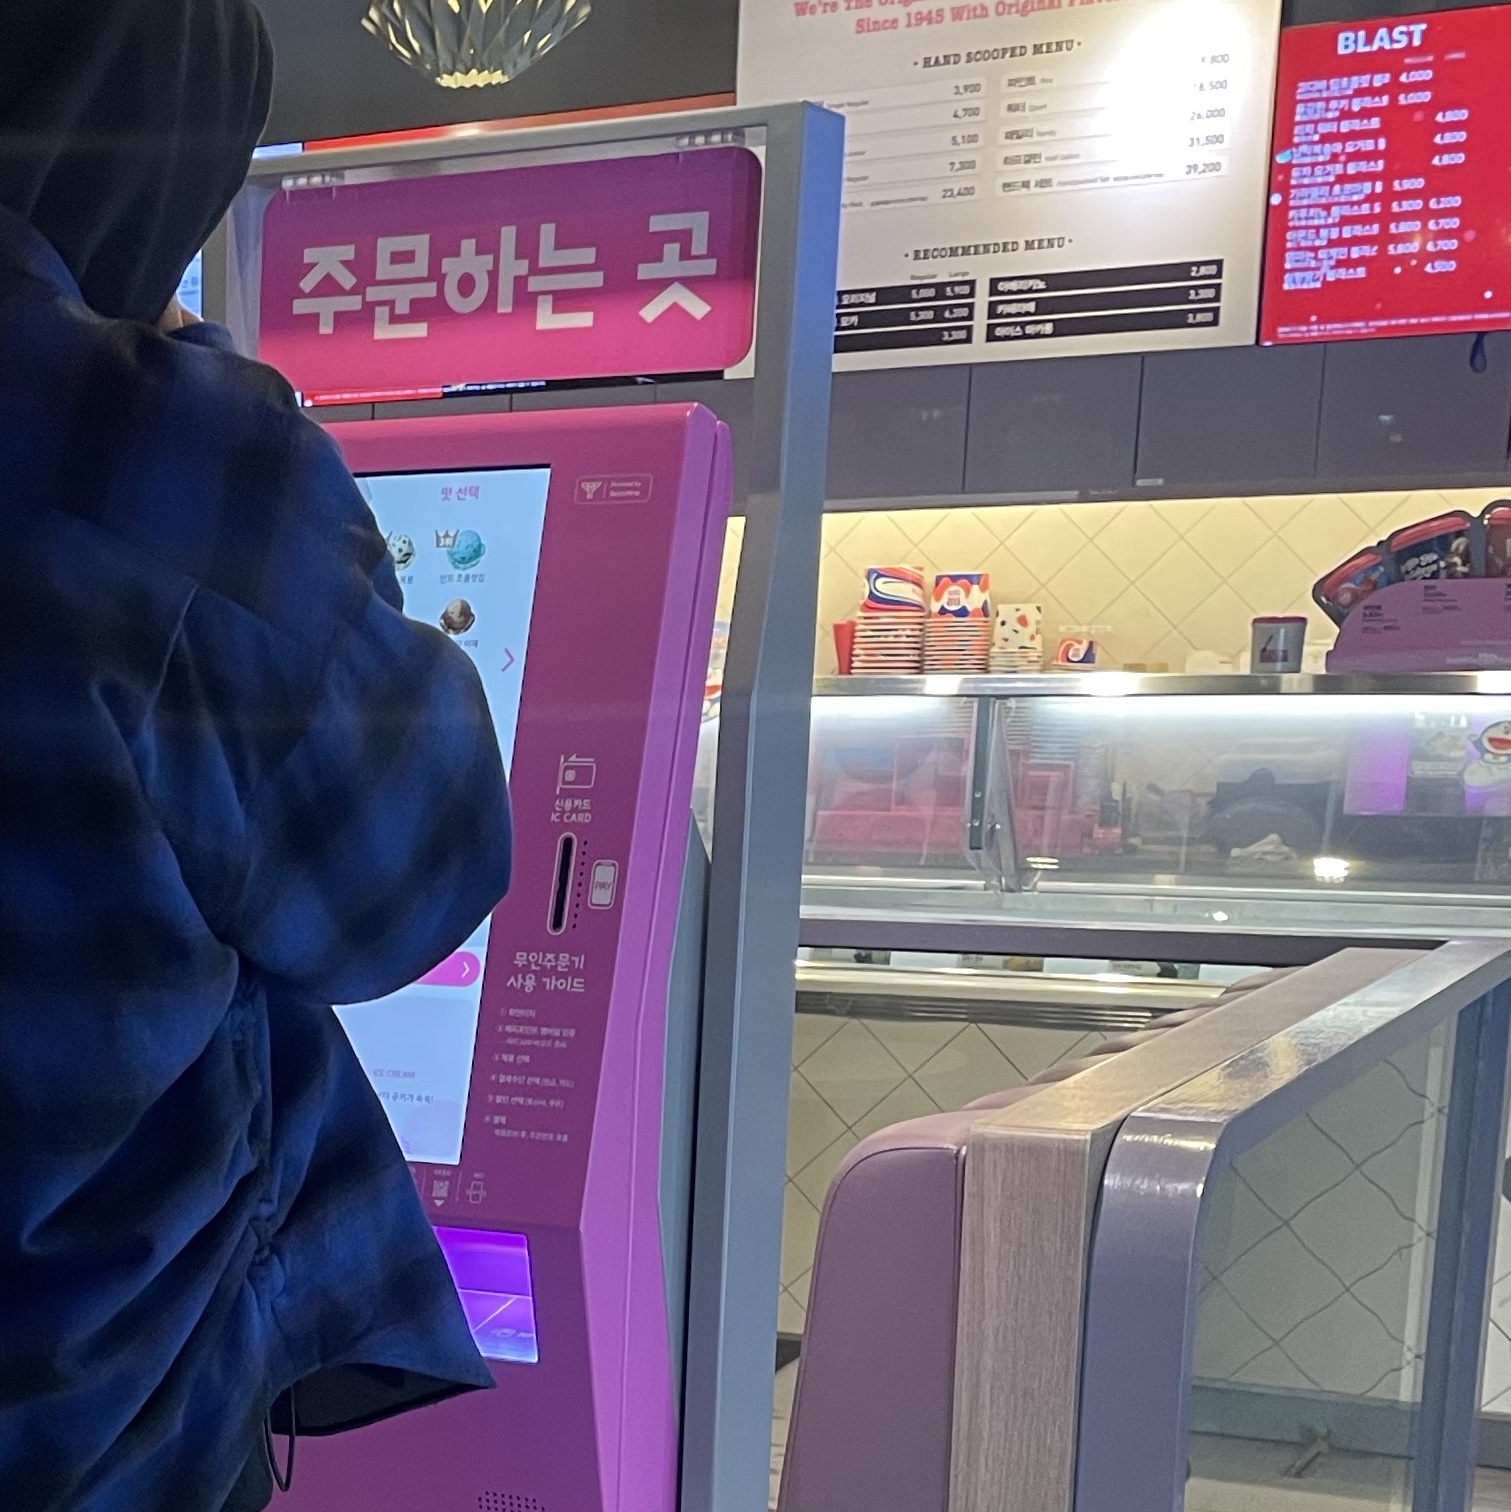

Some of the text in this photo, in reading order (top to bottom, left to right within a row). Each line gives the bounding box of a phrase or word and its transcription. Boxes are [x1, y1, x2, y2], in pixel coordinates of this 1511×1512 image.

[855, 17, 899, 34] Since
[905, 8, 945, 28] 1945
[950, 4, 989, 22] With
[1337, 23, 1428, 55] BLAST
[922, 39, 1076, 69] HAND SCOOPED MENU
[913, 236, 1066, 261] RECOMMENDED MENU
[293, 211, 717, 340] 주문하는 곳
[456, 485, 480, 500] 선택
[554, 799, 592, 811] 신용카드
[551, 813, 592, 823] IC CARD
[513, 951, 585, 972] 무인주문기
[506, 973, 585, 993] 사용 가이드
